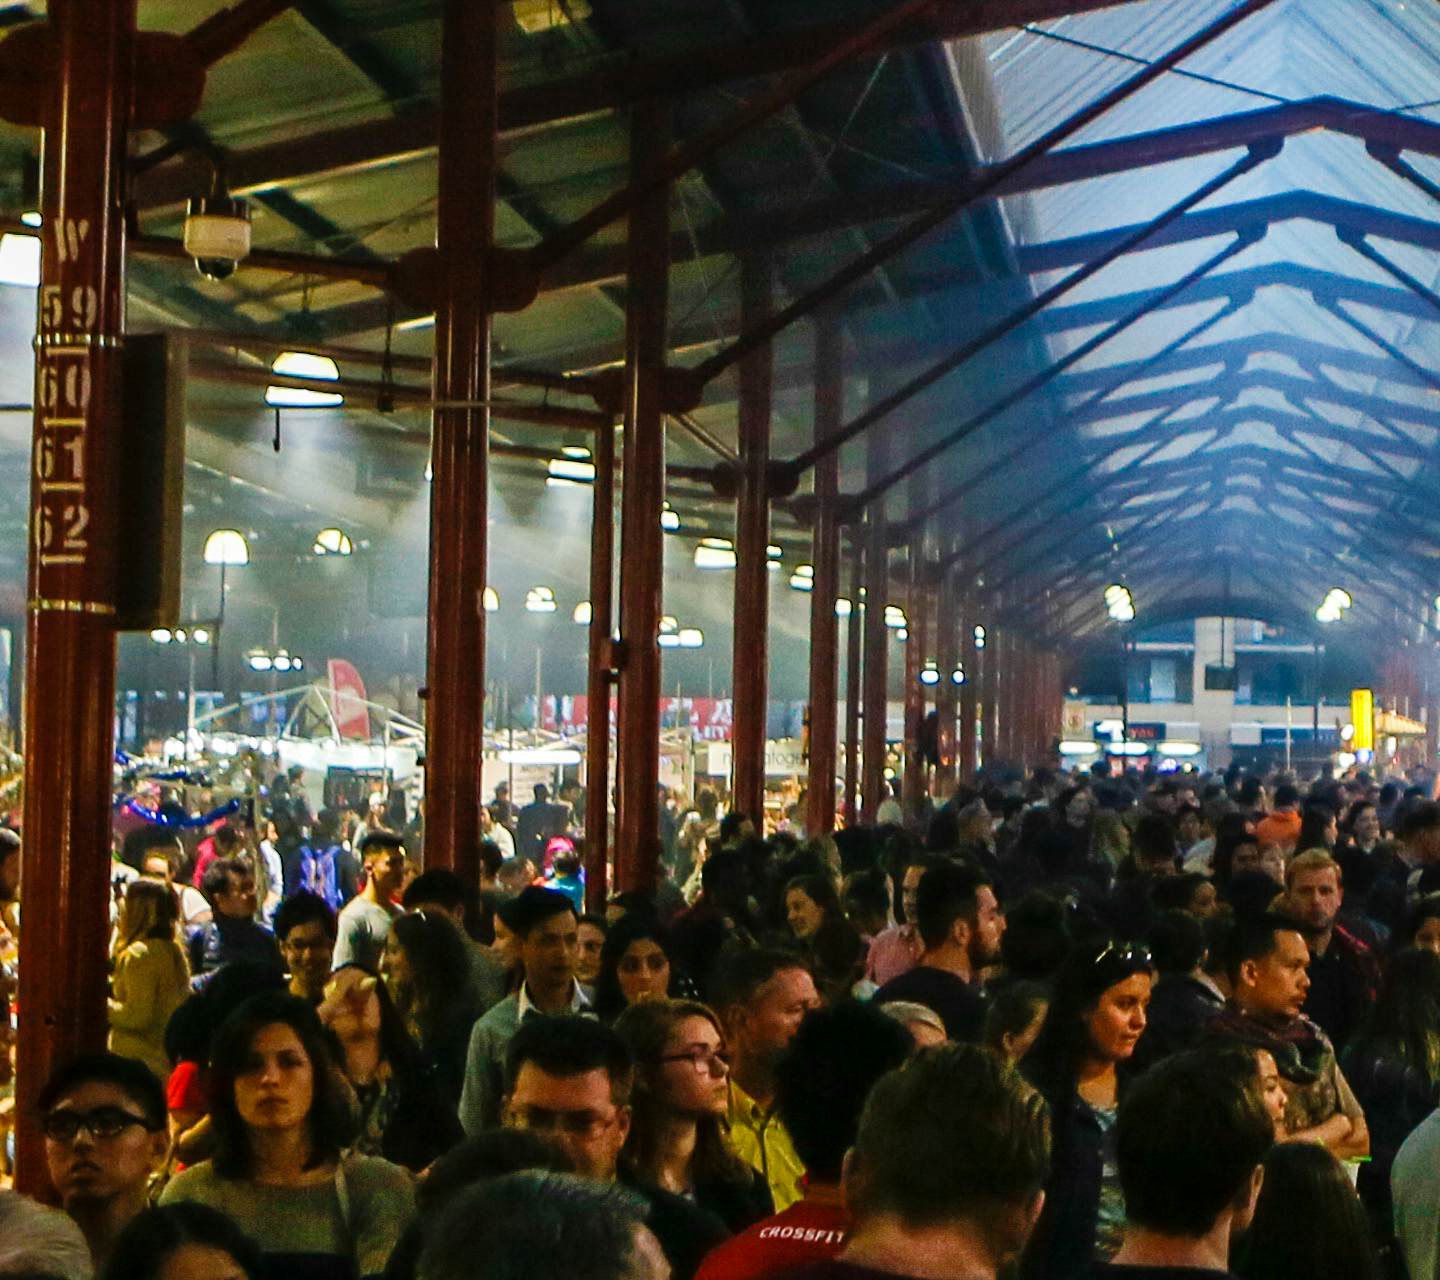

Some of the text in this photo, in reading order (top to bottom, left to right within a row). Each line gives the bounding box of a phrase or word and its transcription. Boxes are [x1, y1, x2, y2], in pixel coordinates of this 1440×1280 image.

[54, 218, 90, 262] W
[41, 285, 97, 328] 59
[39, 364, 91, 408] 60
[36, 435, 86, 479] 61
[35, 504, 90, 549] 62
[760, 1225, 844, 1244] CROSSFIT
